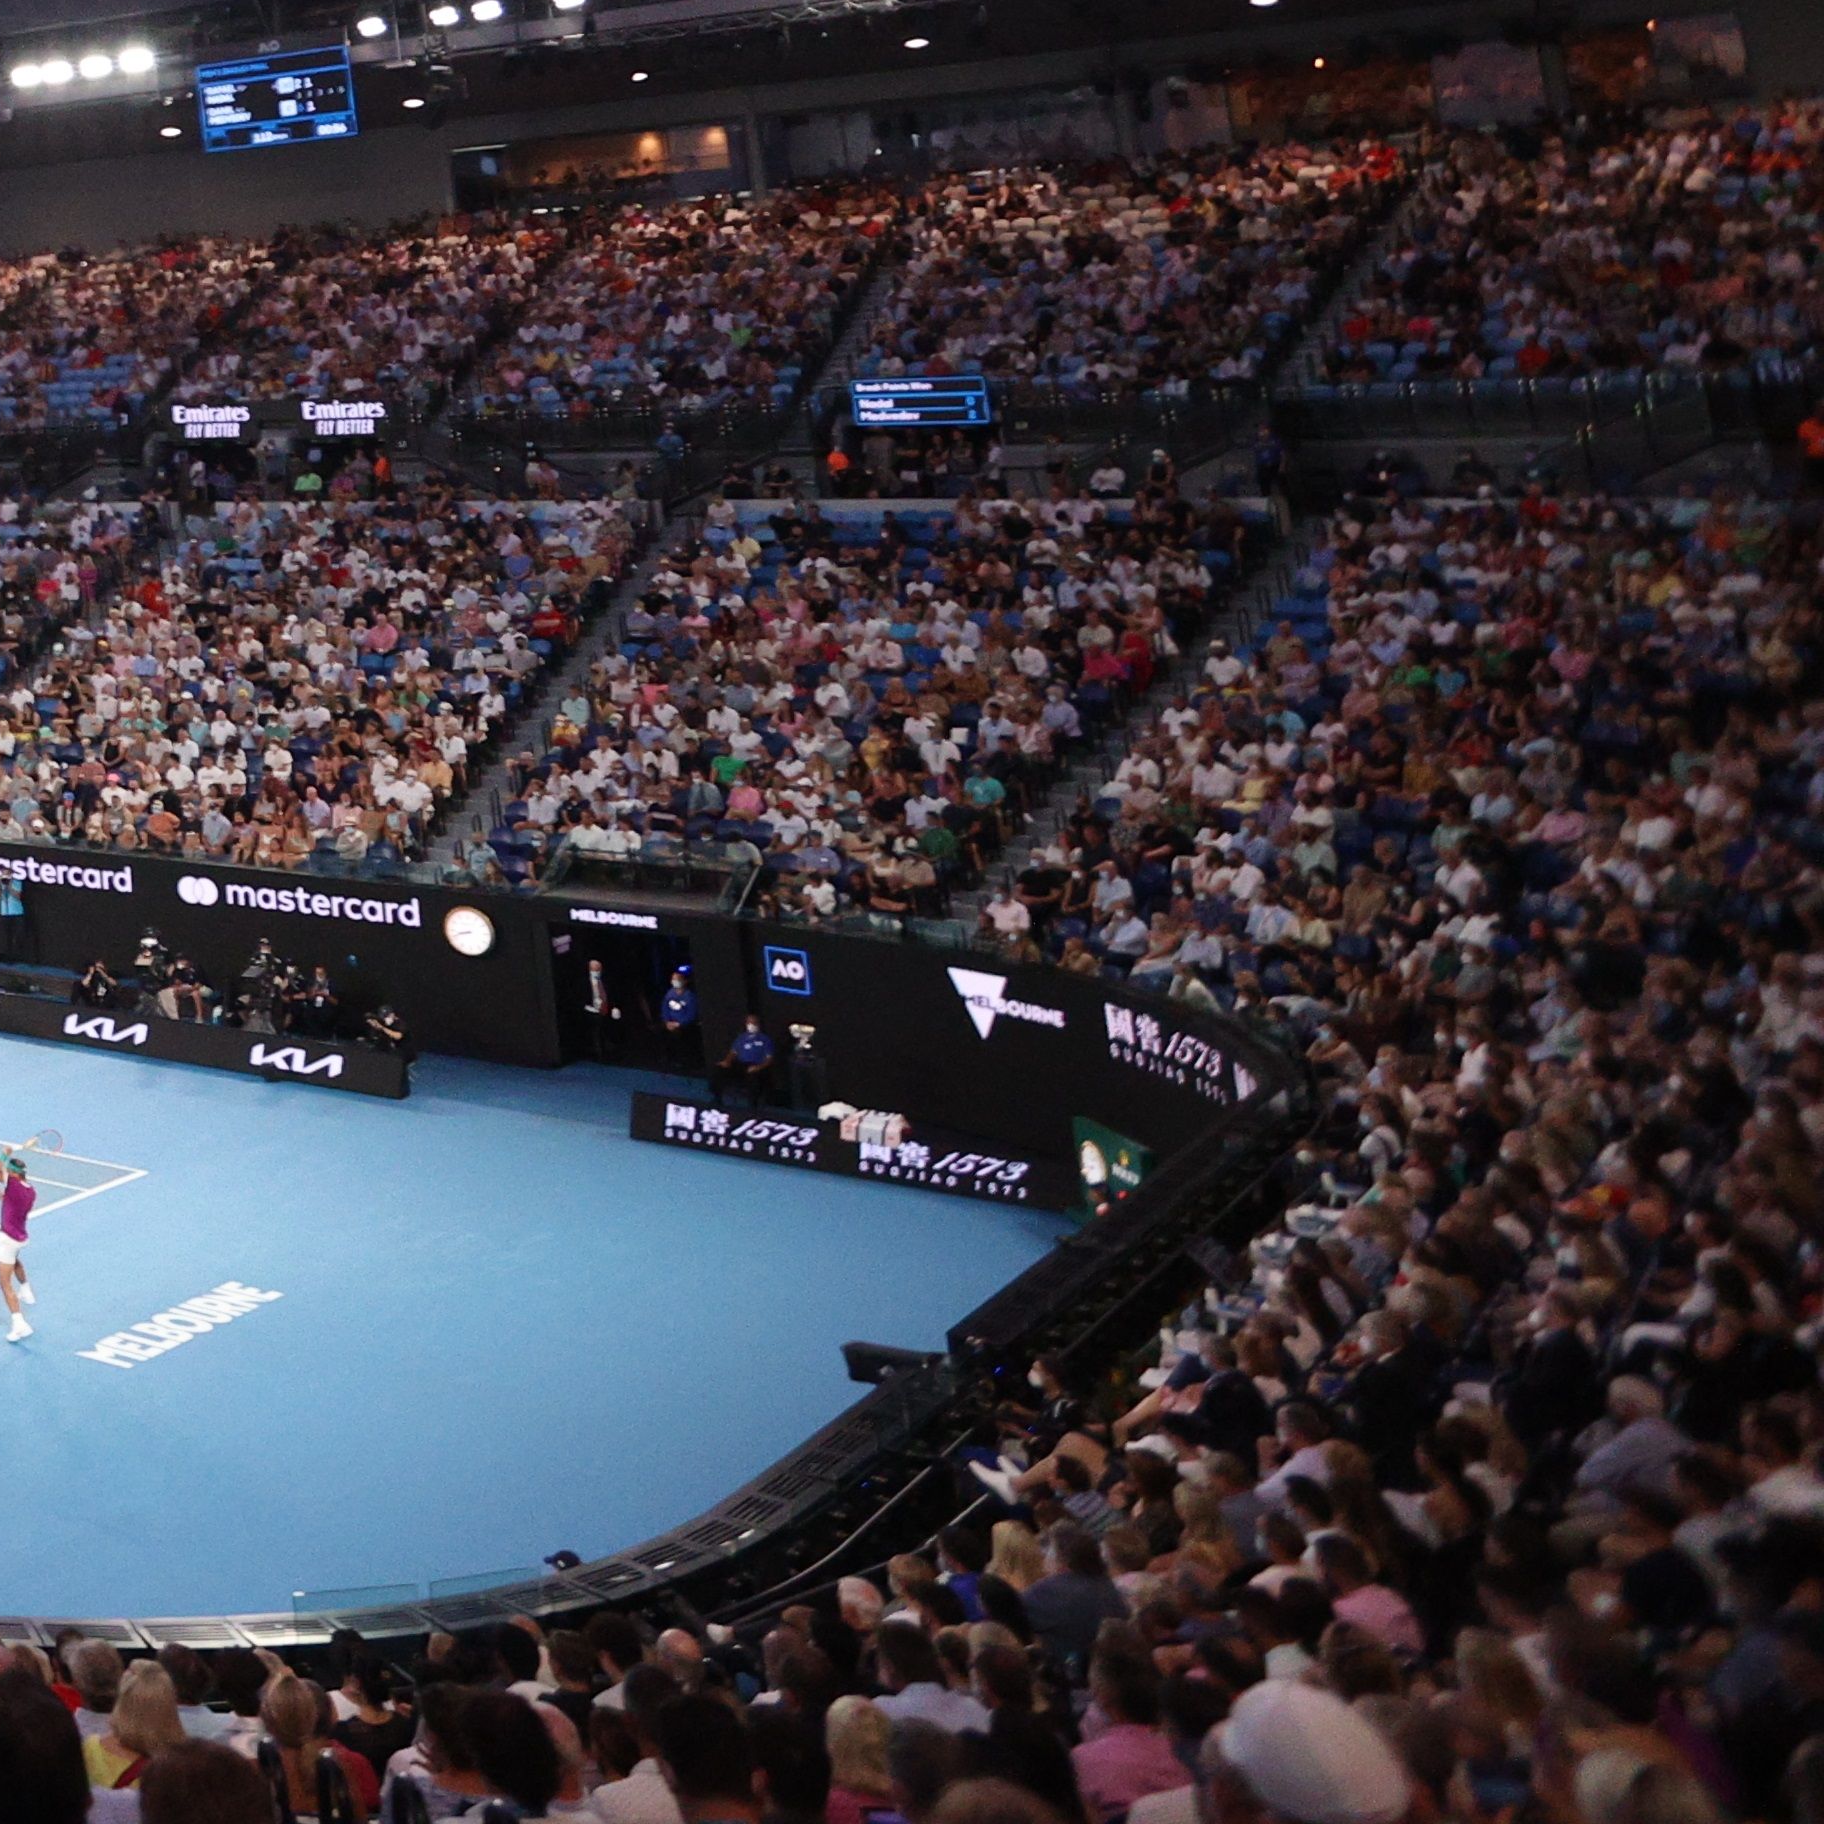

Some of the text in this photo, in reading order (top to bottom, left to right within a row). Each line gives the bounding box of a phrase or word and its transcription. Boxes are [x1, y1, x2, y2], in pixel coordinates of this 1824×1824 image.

[172, 404, 250, 424] Emirates
[302, 400, 385, 420] Emirates
[185, 423, 240, 438] FLY BETTER
[315, 419, 375, 435] FLY BETTER
[225, 883, 421, 928] mastercard
[570, 908, 658, 929] MELBOURNE
[772, 959, 805, 980] AO
[664, 1128, 816, 1163] GUOJIAO 1573
[859, 1160, 957, 1187] GUOJIAO
[75, 1280, 284, 1368] MELBOURNE
